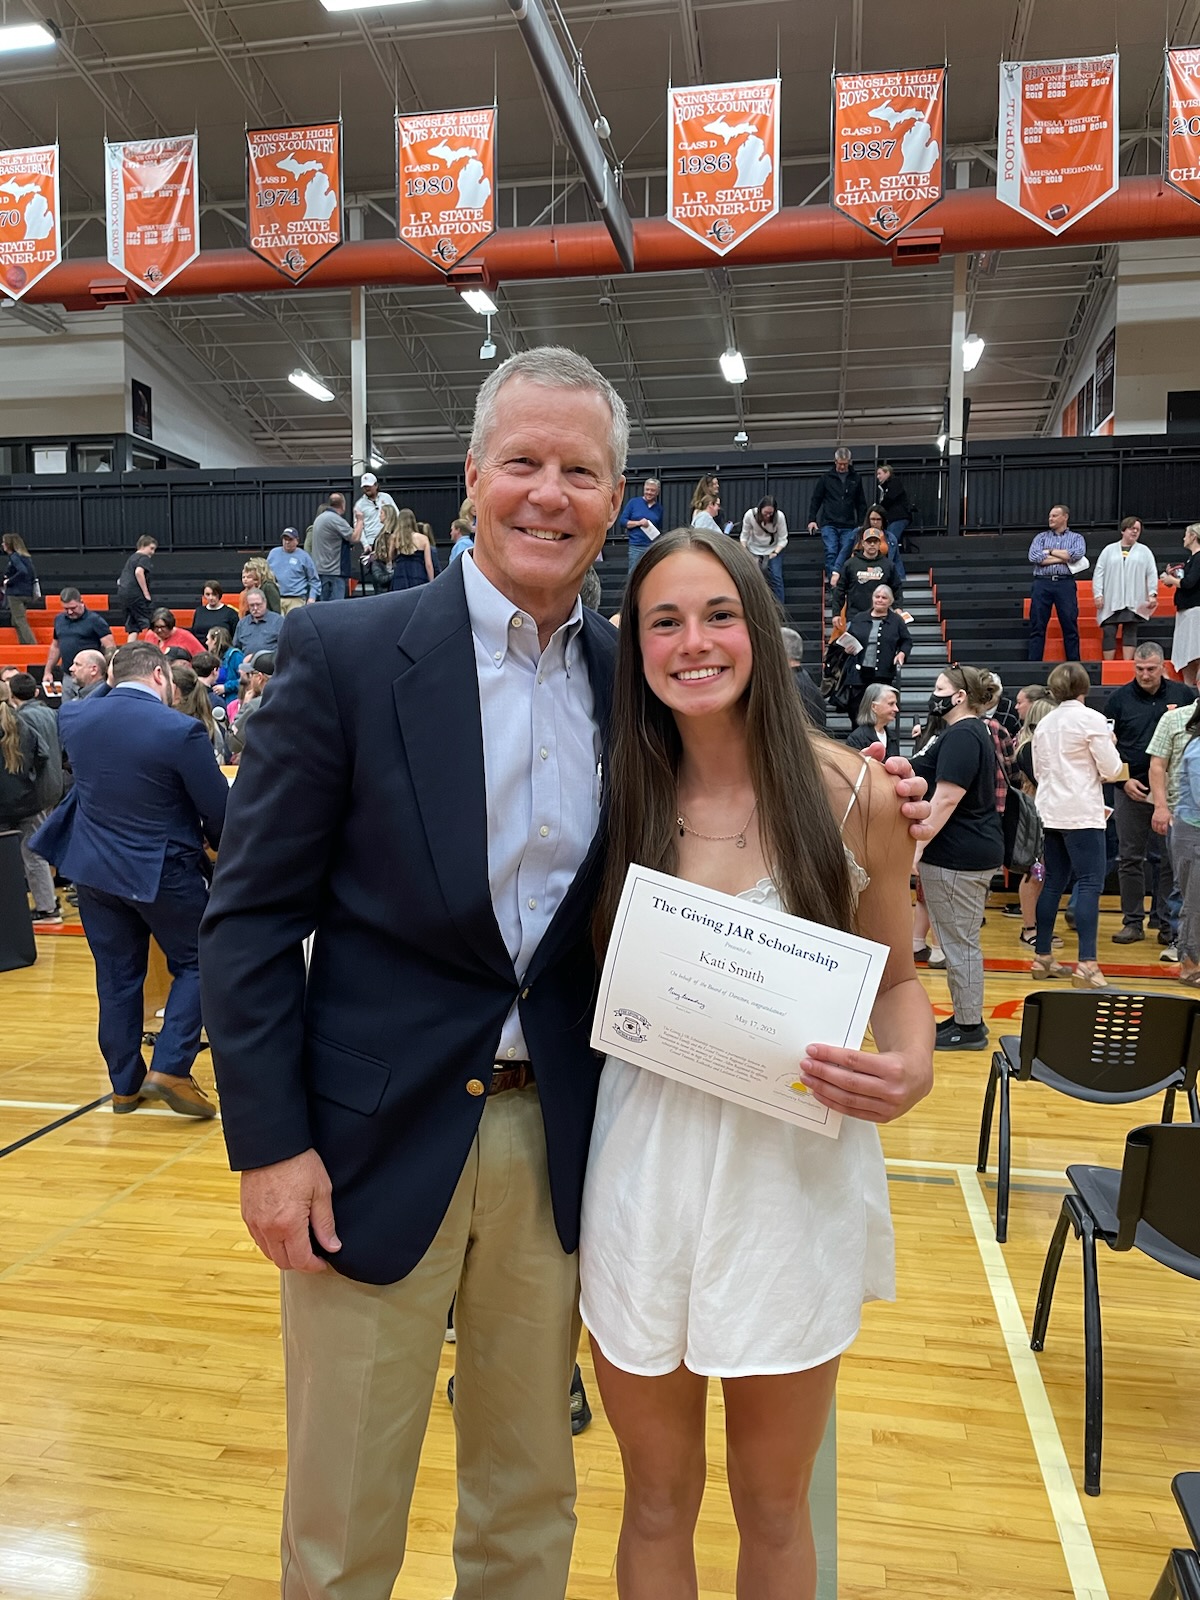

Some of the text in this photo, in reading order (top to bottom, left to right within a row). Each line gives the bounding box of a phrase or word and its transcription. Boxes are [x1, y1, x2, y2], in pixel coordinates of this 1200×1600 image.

[842, 73, 937, 90] KINGSLEY HIGH
[1025, 83, 1044, 92] 2000
[1069, 79, 1089, 88] 2005
[1091, 77, 1110, 88] 2007
[1040, 72, 1097, 83] CONFERENCE
[677, 88, 769, 105] KINGSLEY HIGH
[839, 84, 939, 110] BOYS X-COUNTRY
[1172, 98, 1200, 109] DIVIS
[675, 99, 772, 125] BOYS X-COUNTRY
[1064, 115, 1102, 127] DISTRICT
[404, 113, 488, 130] KINGSLEY HIGH
[841, 125, 882, 136] CLASS D
[1171, 115, 1200, 137] 20
[253, 128, 333, 143] KINGSLEY HIGH
[402, 124, 490, 148] BOYS X-COUNTRY
[1005, 98, 1015, 181] FOOTBALL
[251, 138, 335, 160] BOYS X-COUNTRY
[678, 140, 717, 150] CLASS D
[841, 139, 897, 162] 1987
[26, 153, 51, 164] HIGH
[678, 152, 732, 175] 1986
[0, 161, 54, 177] BASKETBALL
[404, 164, 431, 173] CLASS
[1061, 164, 1104, 176] REGIONAL
[255, 176, 280, 185] CLASS
[404, 176, 454, 197] 1980
[845, 173, 930, 192] L.P. STATE
[111, 168, 120, 226] X-COUNTRY
[256, 188, 299, 209] 1974
[682, 187, 764, 205] L.P. STATE
[836, 186, 940, 206] CHAMPIONS
[409, 209, 484, 226] L.P. STATE
[675, 199, 772, 218] RUNNER-UP
[0, 208, 21, 228] 70
[259, 220, 330, 236] L.P. STATE
[401, 221, 492, 239] CHAMPIONS
[0, 240, 36, 253] STATE
[112, 229, 120, 256] BOYS
[251, 232, 339, 248] CHAMPIONS
[652, 896, 840, 972] The Giving JAR Scholarship
[698, 950, 766, 984] Kati Smith
[707, 983, 722, 993] Board
[734, 1014, 776, 1036] May 17, 2023
